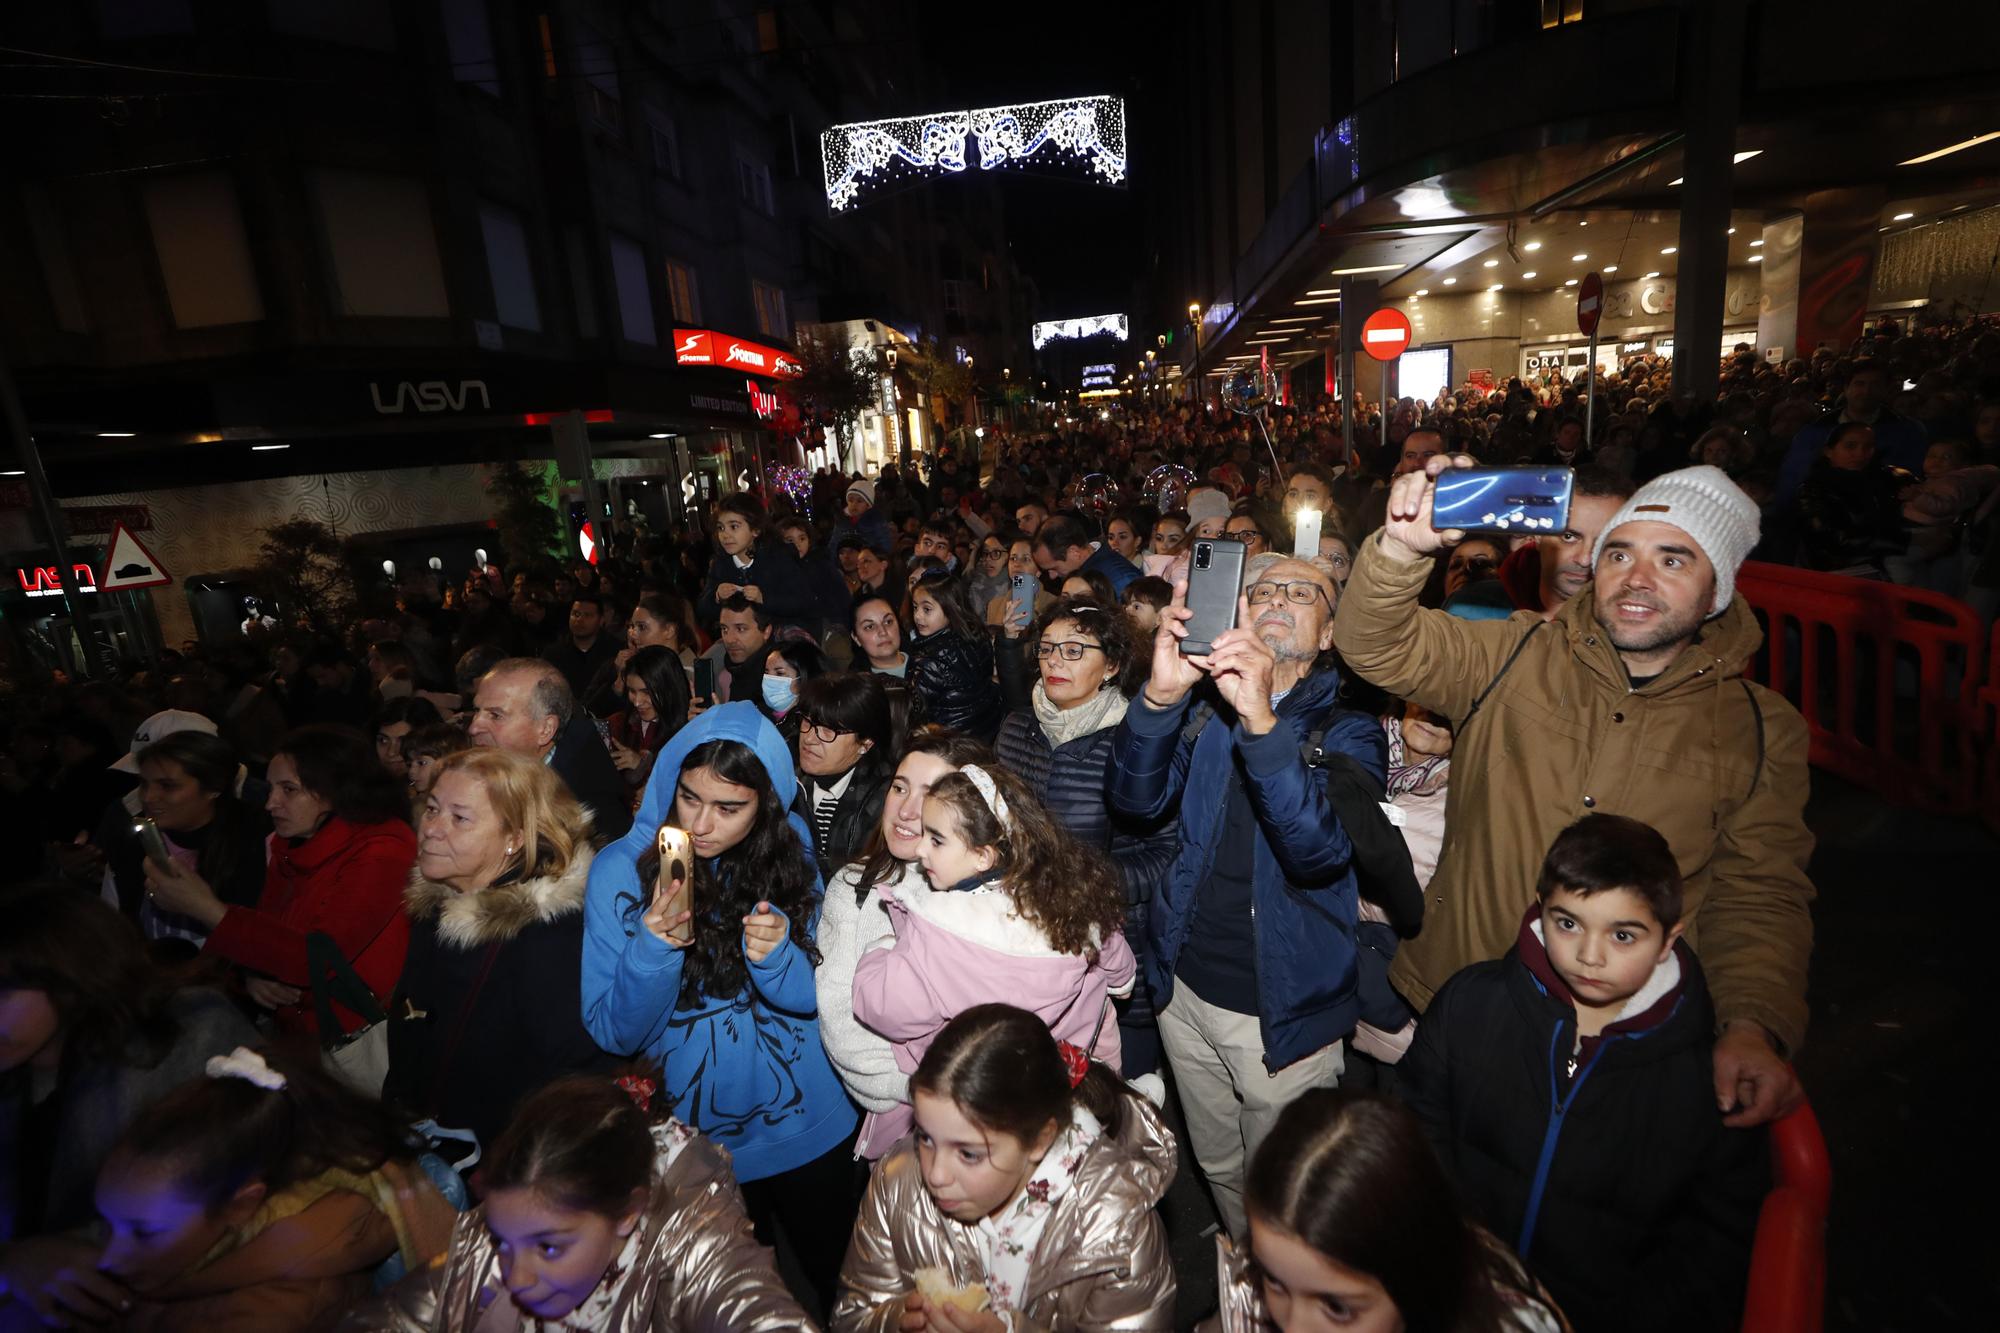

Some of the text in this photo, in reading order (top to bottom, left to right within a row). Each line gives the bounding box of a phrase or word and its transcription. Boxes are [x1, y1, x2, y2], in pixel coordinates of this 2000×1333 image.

[725, 343, 764, 367] SPORTIUM
[1529, 356, 1560, 368] ORA
[689, 394, 720, 410] LIMITED
